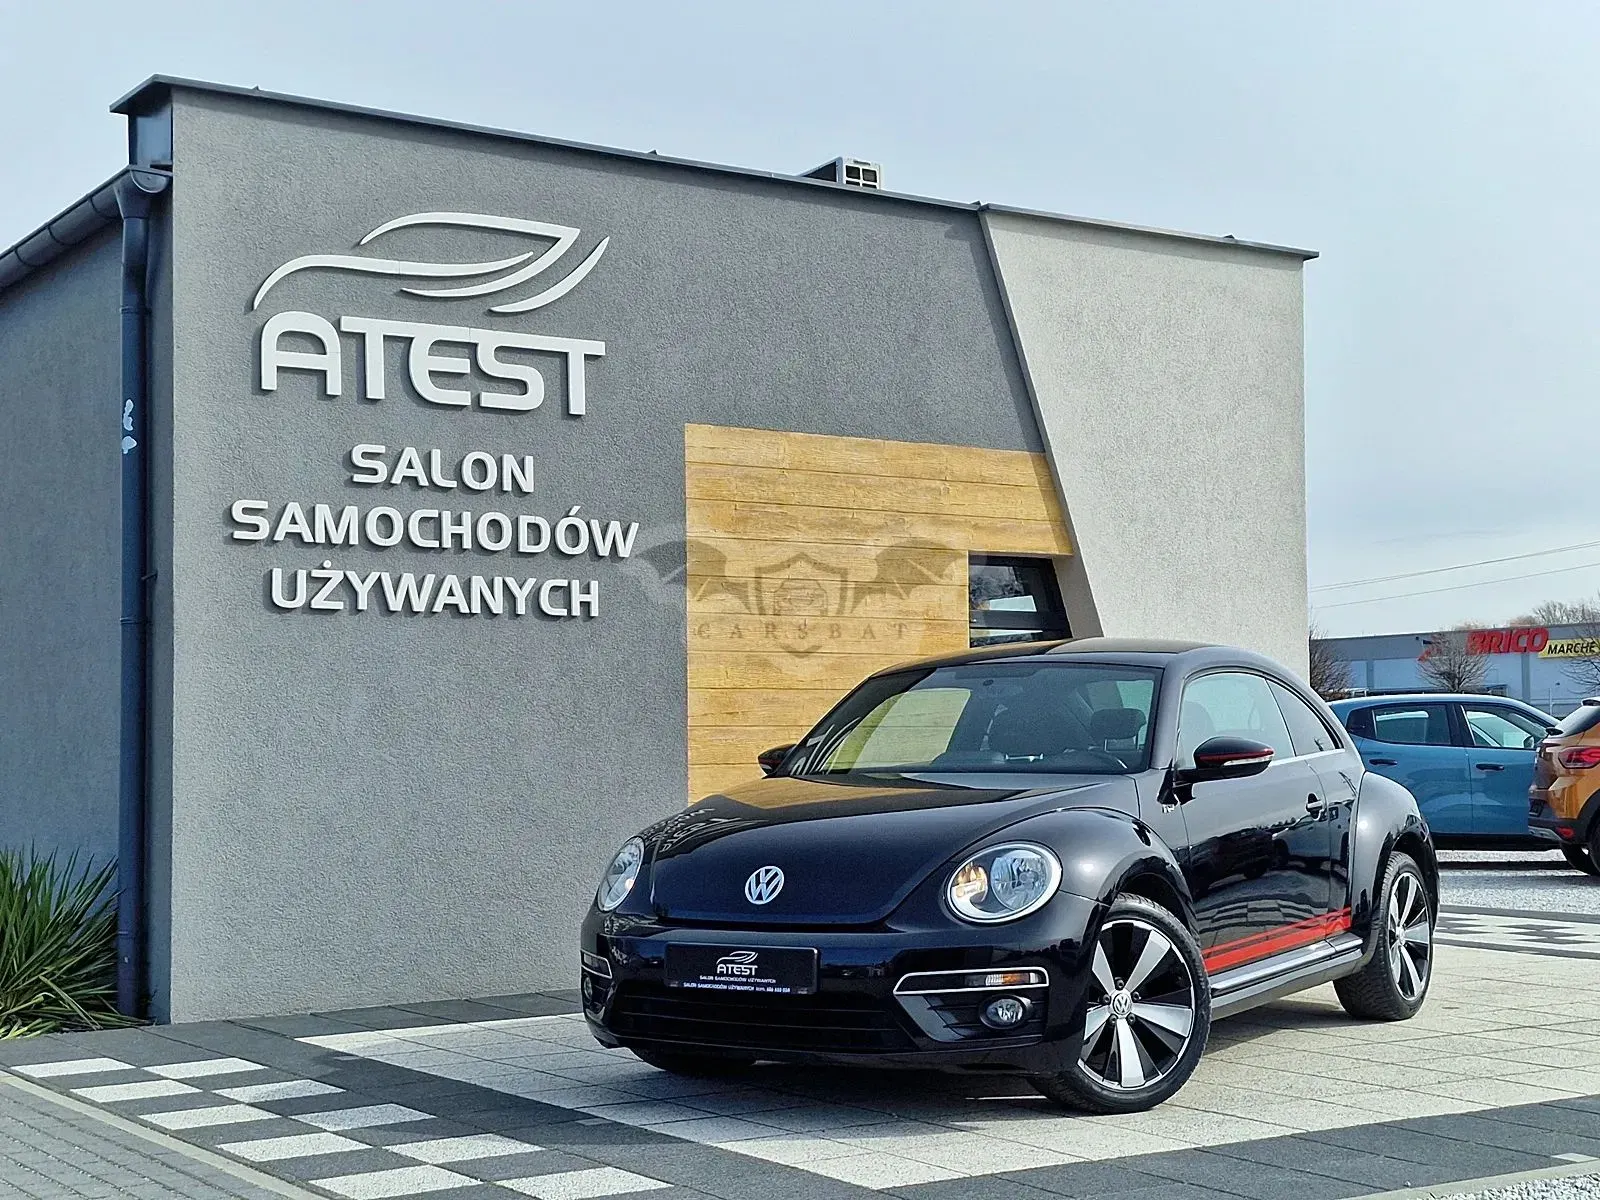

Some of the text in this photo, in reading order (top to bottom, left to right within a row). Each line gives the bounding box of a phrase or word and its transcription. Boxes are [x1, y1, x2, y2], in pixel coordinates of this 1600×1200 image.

[260, 310, 606, 416] ATEST
[350, 443, 535, 493] SALON
[230, 499, 640, 558] SAMOCHODÓW
[270, 559, 600, 618] UŻYWANYCH
[1466, 627, 1549, 655] BRICO
[716, 963, 758, 976] ATEST
